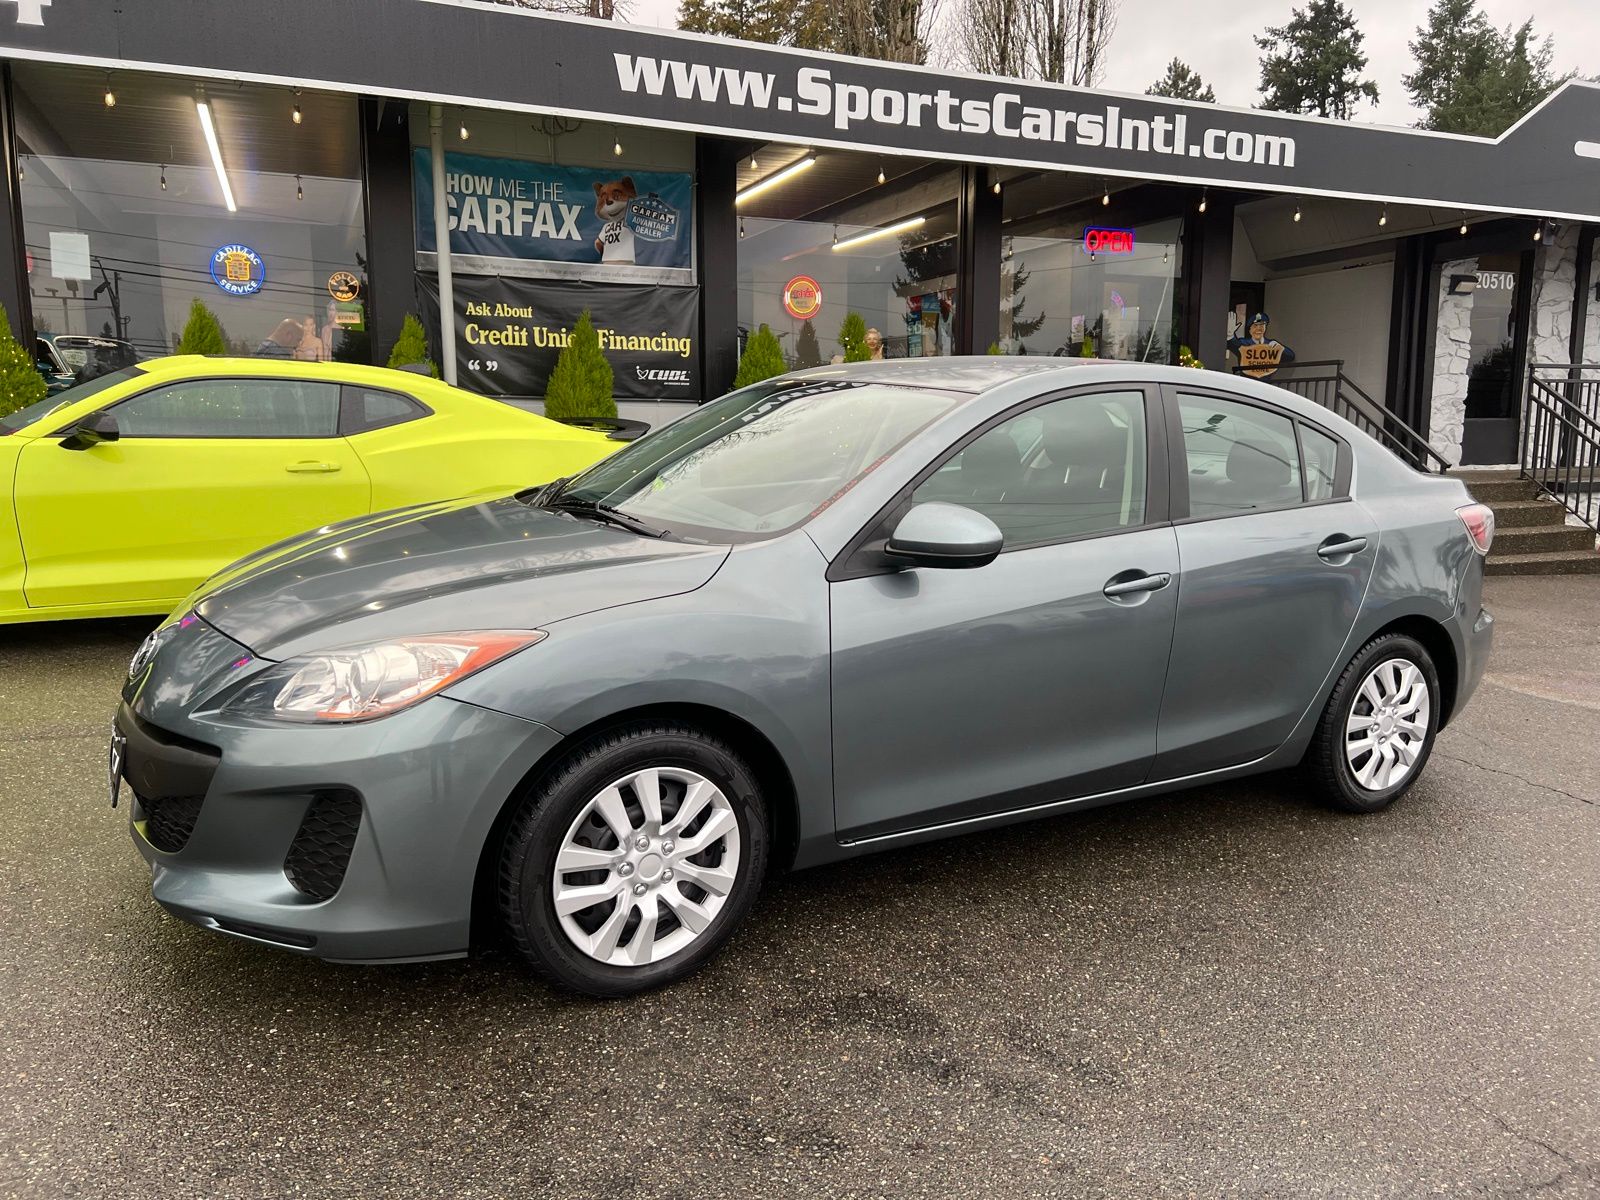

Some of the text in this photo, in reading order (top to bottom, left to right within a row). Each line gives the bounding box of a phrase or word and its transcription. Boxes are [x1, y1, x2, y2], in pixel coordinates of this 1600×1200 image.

[613, 53, 1296, 167] www.SportsCarsIntl.com
[445, 173, 564, 201] HOW ME THE
[631, 204, 674, 224] CARFAX
[605, 221, 622, 233] CAR
[631, 216, 670, 232] ADVANTAGE
[635, 226, 662, 238] DEALER
[605, 232, 621, 244] FOX
[1086, 230, 1133, 252] OPEN
[215, 245, 261, 265] CADILLAC
[219, 279, 258, 293] SERVICE
[1476, 273, 1514, 290] 20510
[466, 302, 533, 318] Ask About
[465, 323, 528, 346] Credit
[597, 329, 692, 358] Financing
[1246, 349, 1279, 360] SLOW
